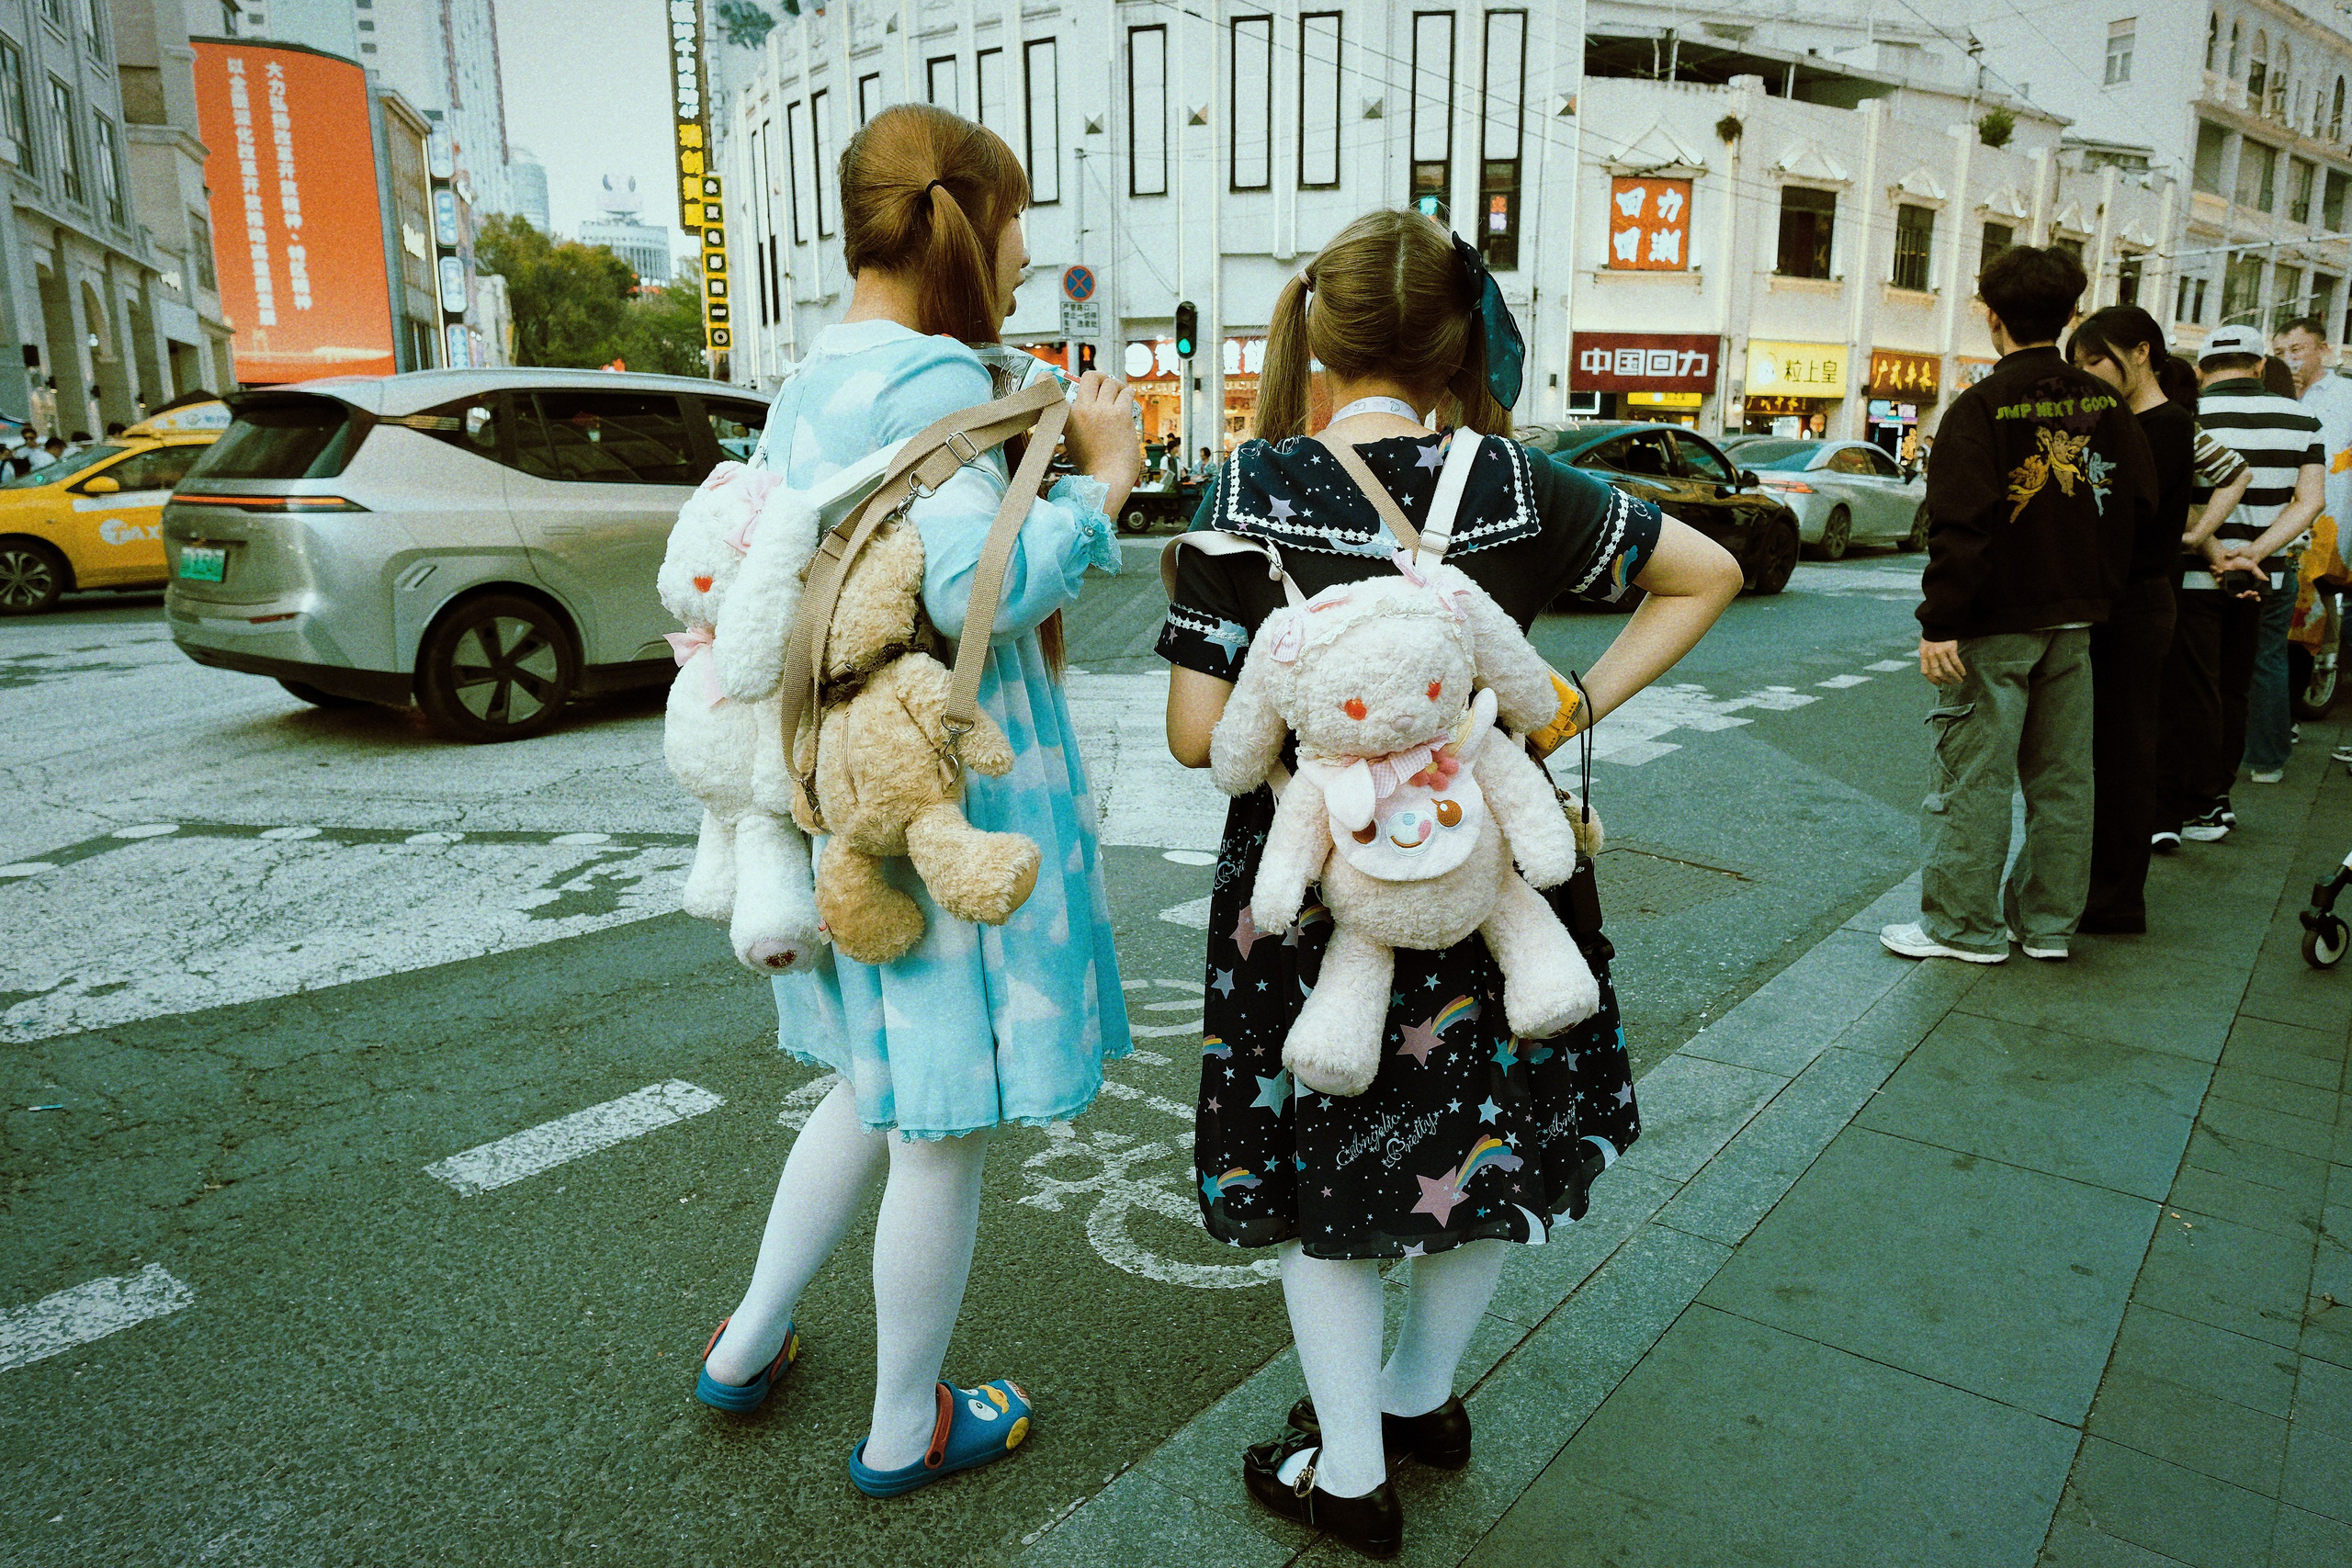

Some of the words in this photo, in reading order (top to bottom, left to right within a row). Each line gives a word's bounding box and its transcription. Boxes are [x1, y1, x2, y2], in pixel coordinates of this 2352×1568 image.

[1580, 347, 1710, 378] 中国回力
[1784, 359, 1838, 384] 粒上皇
[2035, 400, 2075, 418] NEXT
